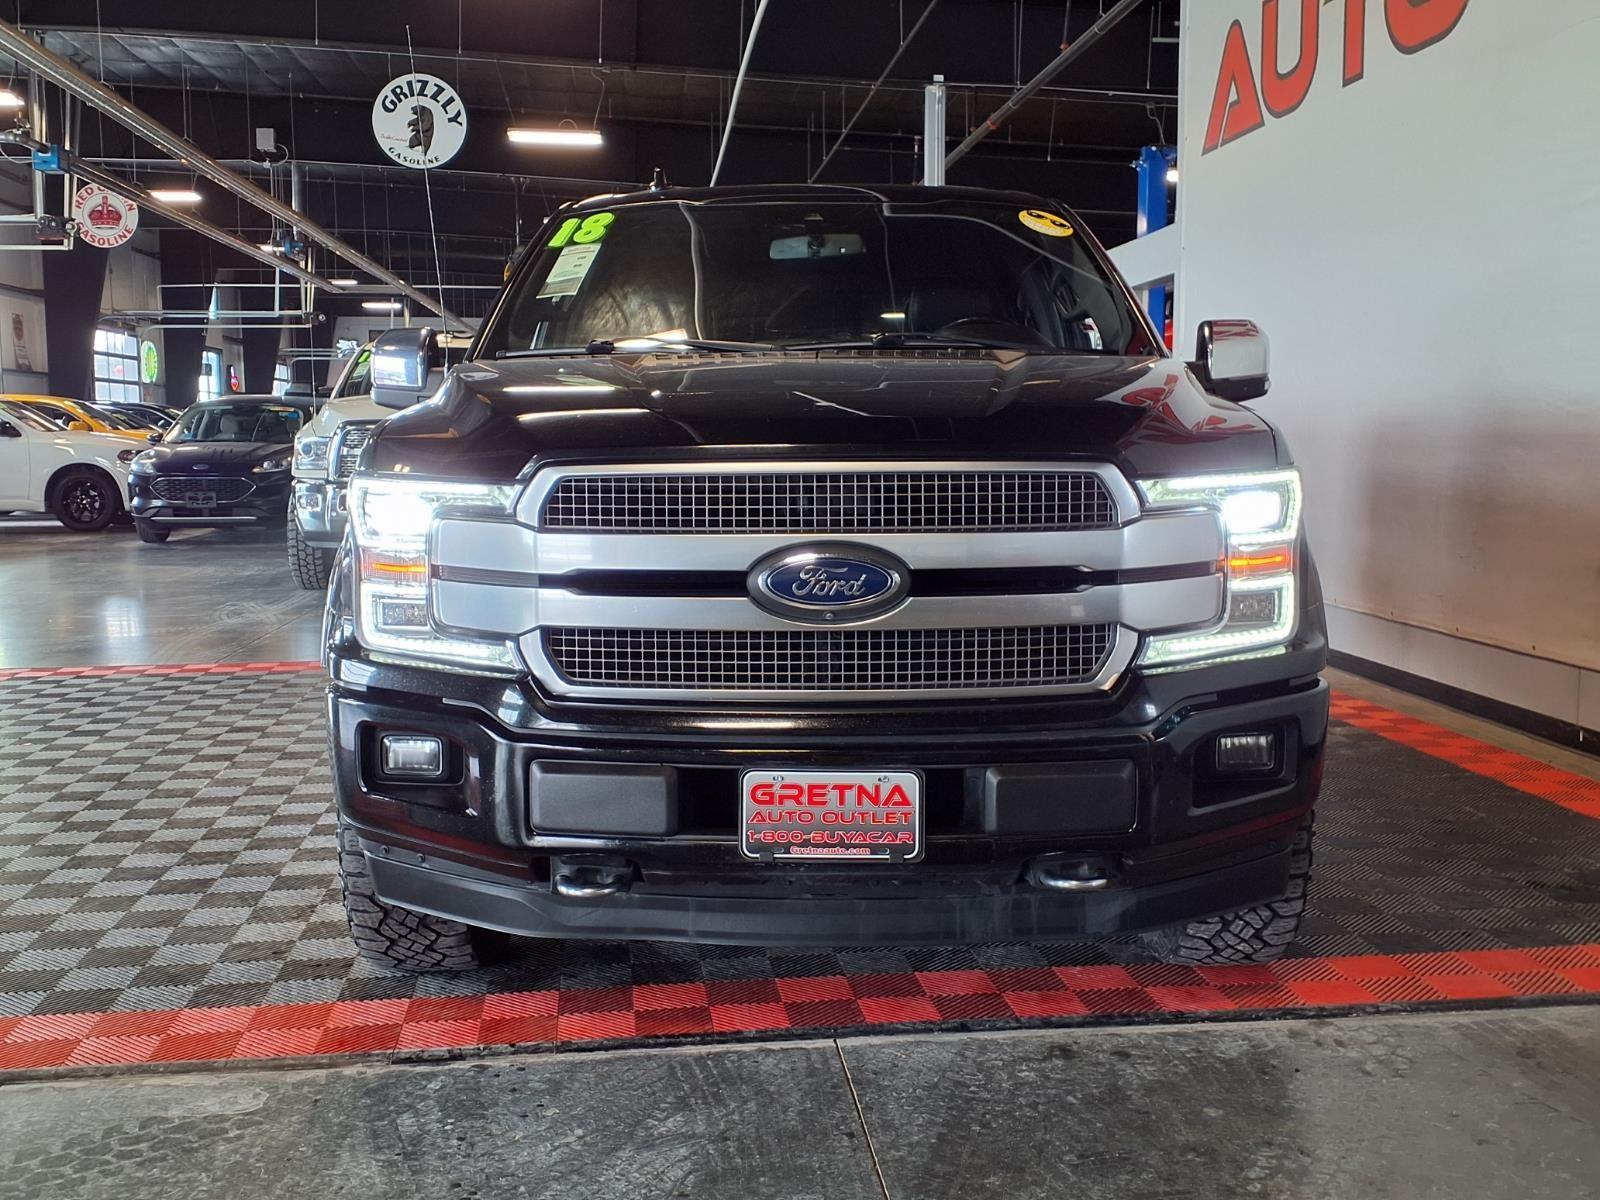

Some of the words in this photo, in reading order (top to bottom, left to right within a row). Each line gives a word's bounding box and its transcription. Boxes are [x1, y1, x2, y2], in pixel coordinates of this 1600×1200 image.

[381, 79, 463, 127] GRIZZLY
[388, 146, 440, 165] GASOLINE
[75, 186, 94, 209] RED
[547, 212, 615, 247] 18
[792, 565, 867, 596] Ford
[749, 782, 913, 808] GRETNA
[748, 810, 815, 825] AUTO
[820, 810, 914, 825] OUTLET
[747, 830, 913, 844] 1-800-BUYACAR
